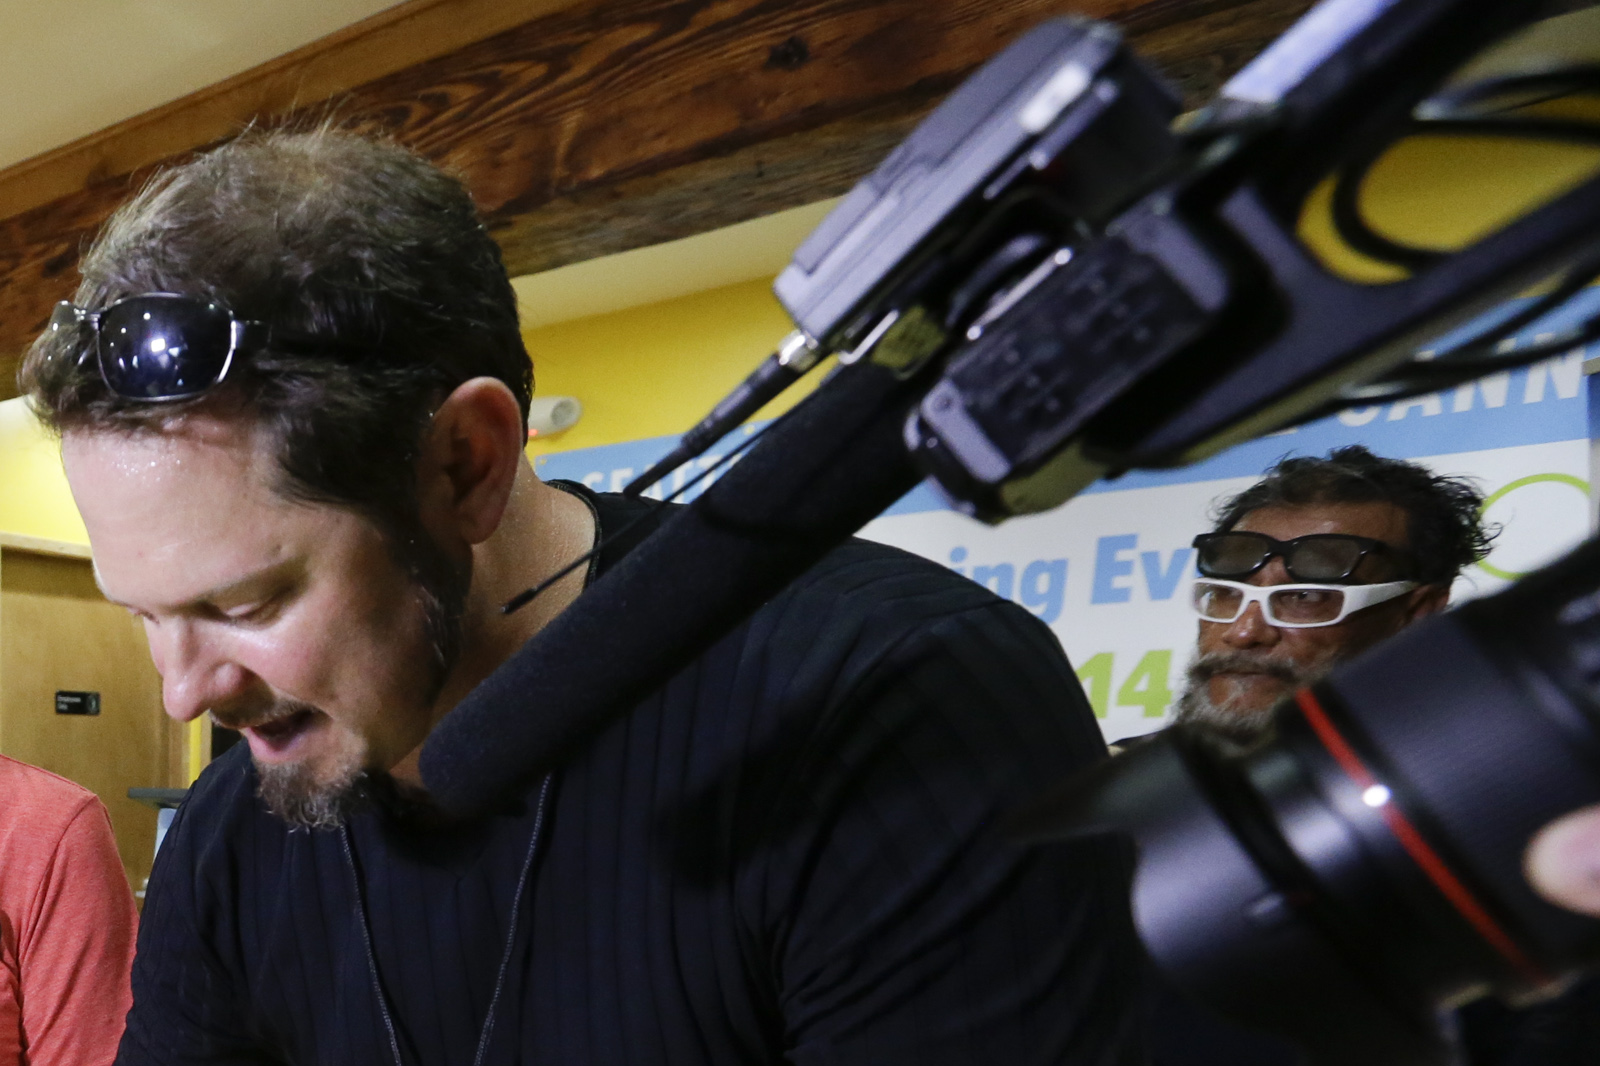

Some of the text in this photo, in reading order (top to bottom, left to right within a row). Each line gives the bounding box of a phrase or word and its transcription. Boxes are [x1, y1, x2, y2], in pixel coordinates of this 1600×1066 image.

[581, 451, 746, 505] SEATT
[949, 533, 1195, 625] ing Ev
